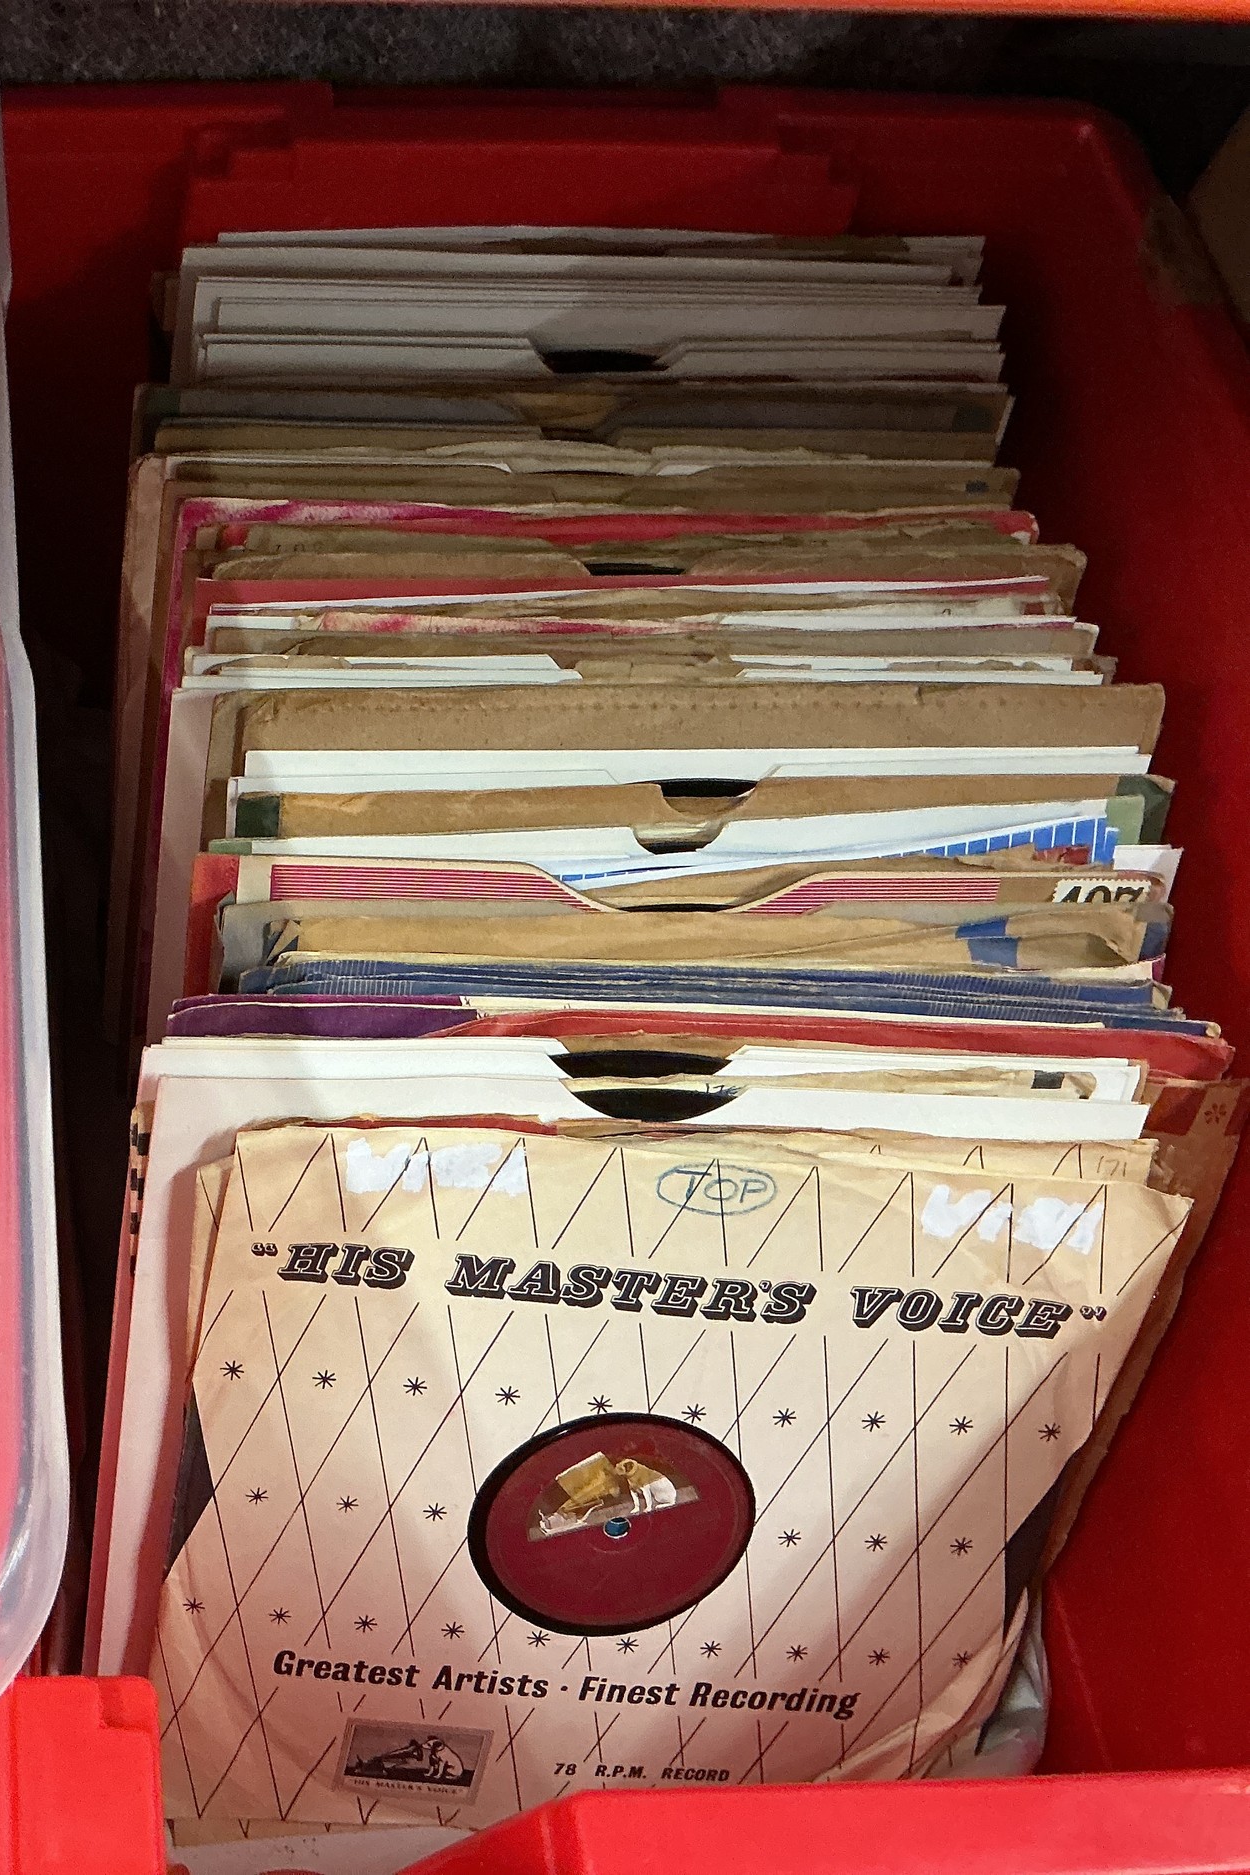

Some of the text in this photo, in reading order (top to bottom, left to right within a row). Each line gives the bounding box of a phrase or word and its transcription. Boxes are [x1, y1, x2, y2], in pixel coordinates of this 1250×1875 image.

[674, 1168, 768, 1204] TOP
[251, 1241, 1108, 1339] “HIS MASTER'S VOICE”
[273, 1648, 859, 1720] Greatest Artists Finest Recording
[553, 1762, 731, 1782] 78 R.P.M. RECORD
